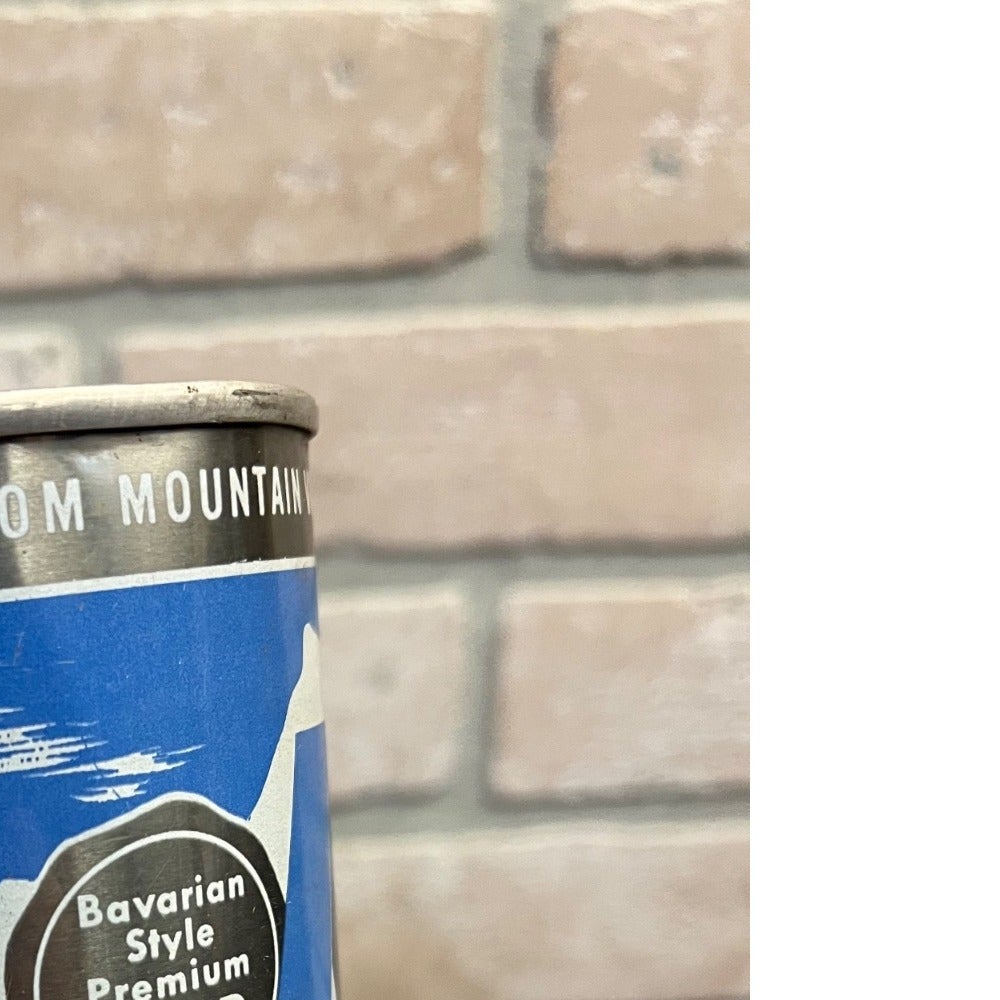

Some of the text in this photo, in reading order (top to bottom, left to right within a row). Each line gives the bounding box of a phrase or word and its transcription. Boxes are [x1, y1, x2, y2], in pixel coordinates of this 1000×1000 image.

[118, 466, 302, 526] MOUNTAIN
[77, 875, 246, 929] Bavarian
[125, 917, 215, 963] Style
